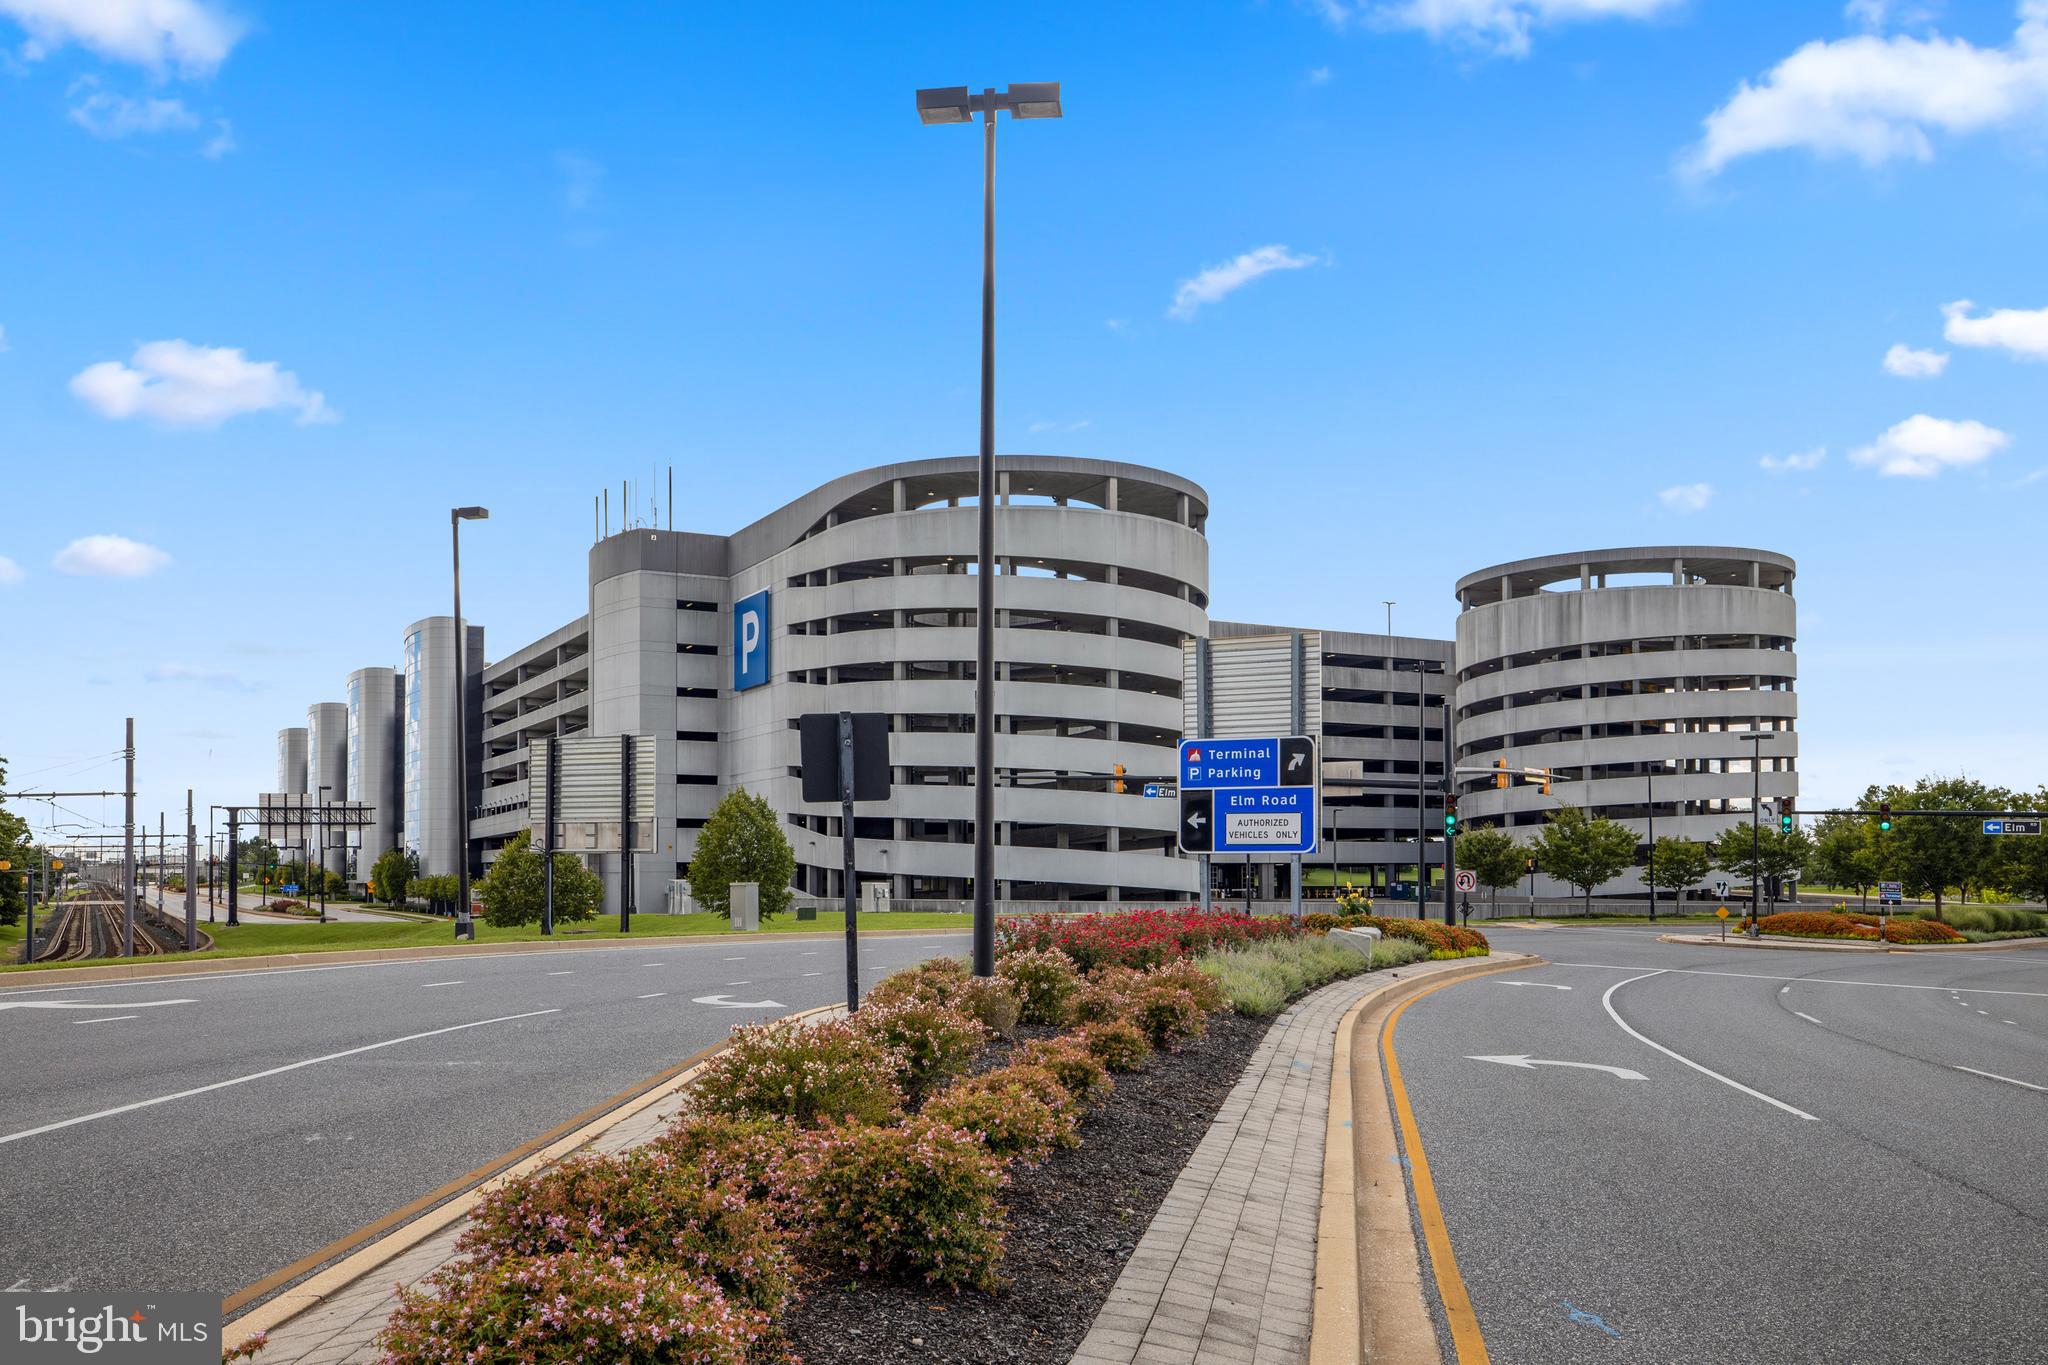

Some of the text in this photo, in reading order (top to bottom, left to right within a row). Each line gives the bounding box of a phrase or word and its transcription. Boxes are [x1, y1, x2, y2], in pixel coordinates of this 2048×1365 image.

[742, 610, 760, 675] P
[1208, 747, 1270, 760] Terminal
[1208, 767, 1261, 780] Parking
[1158, 787, 1176, 797] Elm
[1231, 794, 1297, 806] Elm Road
[1237, 818, 1289, 827] AUTHORIZED
[2004, 823, 2026, 832] Elm
[1228, 830, 1299, 839] VEHICLES ONLY
